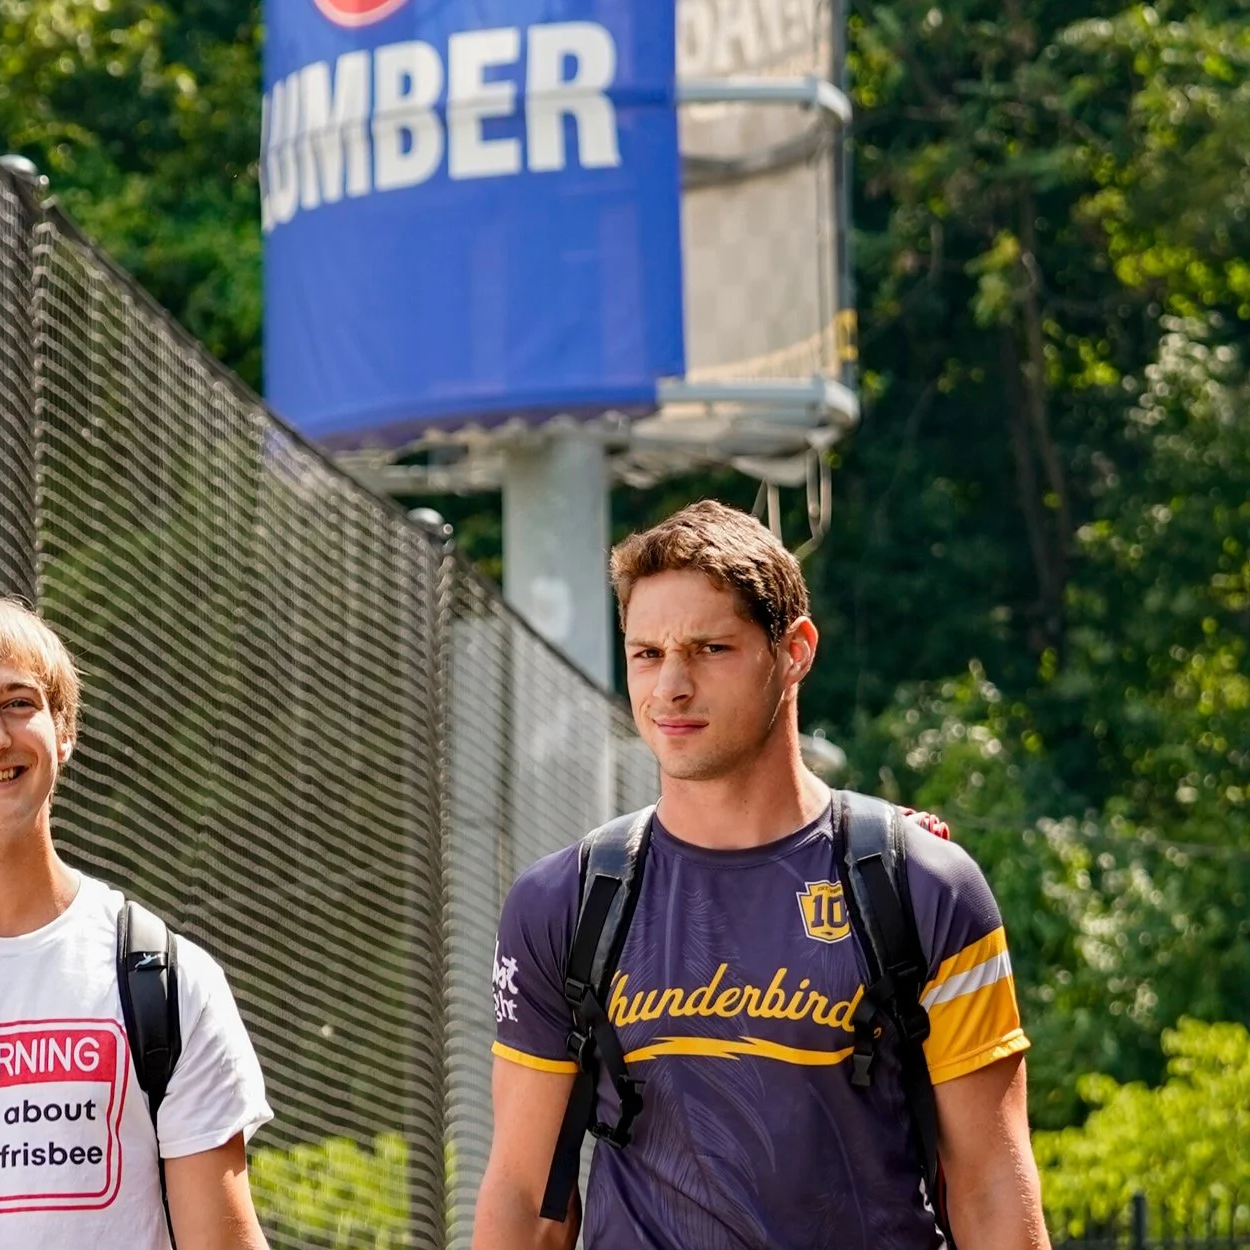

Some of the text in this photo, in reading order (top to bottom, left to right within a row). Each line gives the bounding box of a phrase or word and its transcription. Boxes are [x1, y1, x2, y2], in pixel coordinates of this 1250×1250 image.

[607, 963, 881, 1033] hunderbird
[4, 1099, 96, 1125] about
[0, 1142, 103, 1169] frisbee
